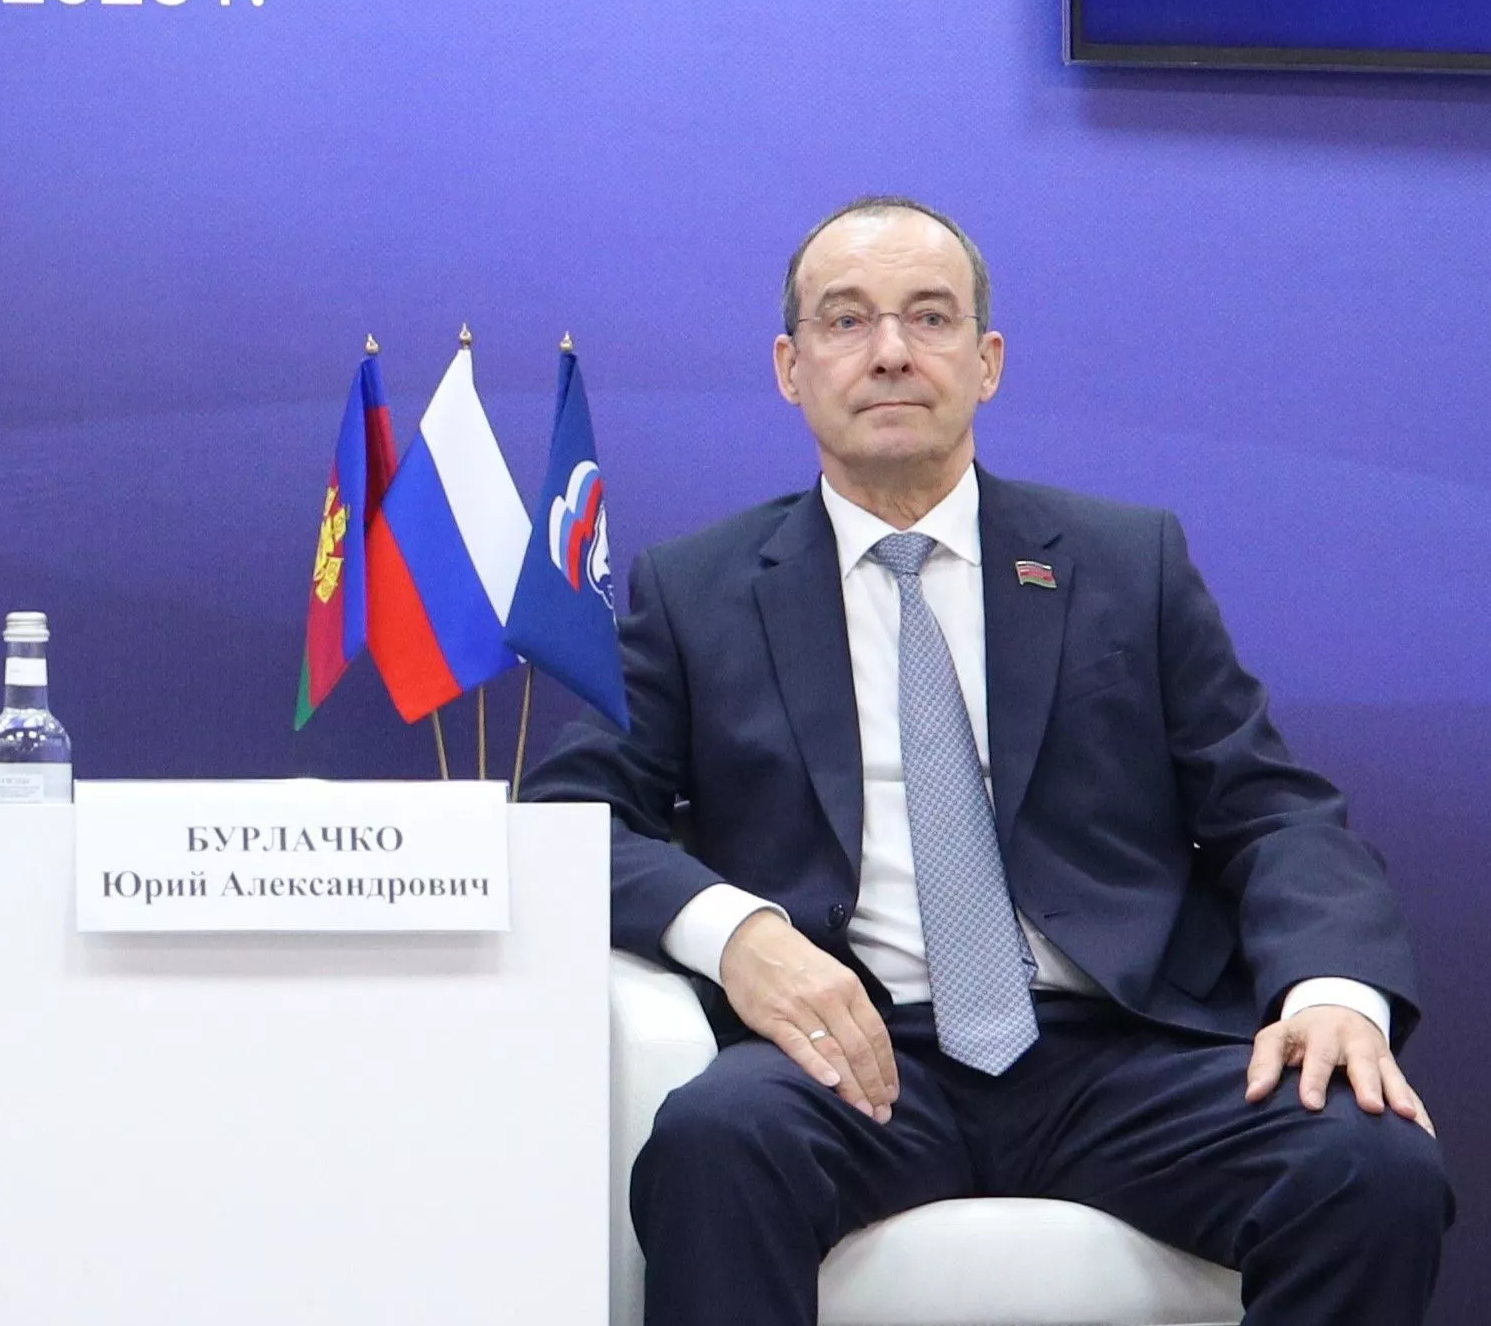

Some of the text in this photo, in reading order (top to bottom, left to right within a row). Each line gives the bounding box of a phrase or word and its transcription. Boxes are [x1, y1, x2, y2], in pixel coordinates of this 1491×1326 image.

[186, 825, 405, 853] БУРЛАЧКО
[101, 870, 490, 905] Юрий Александрович
